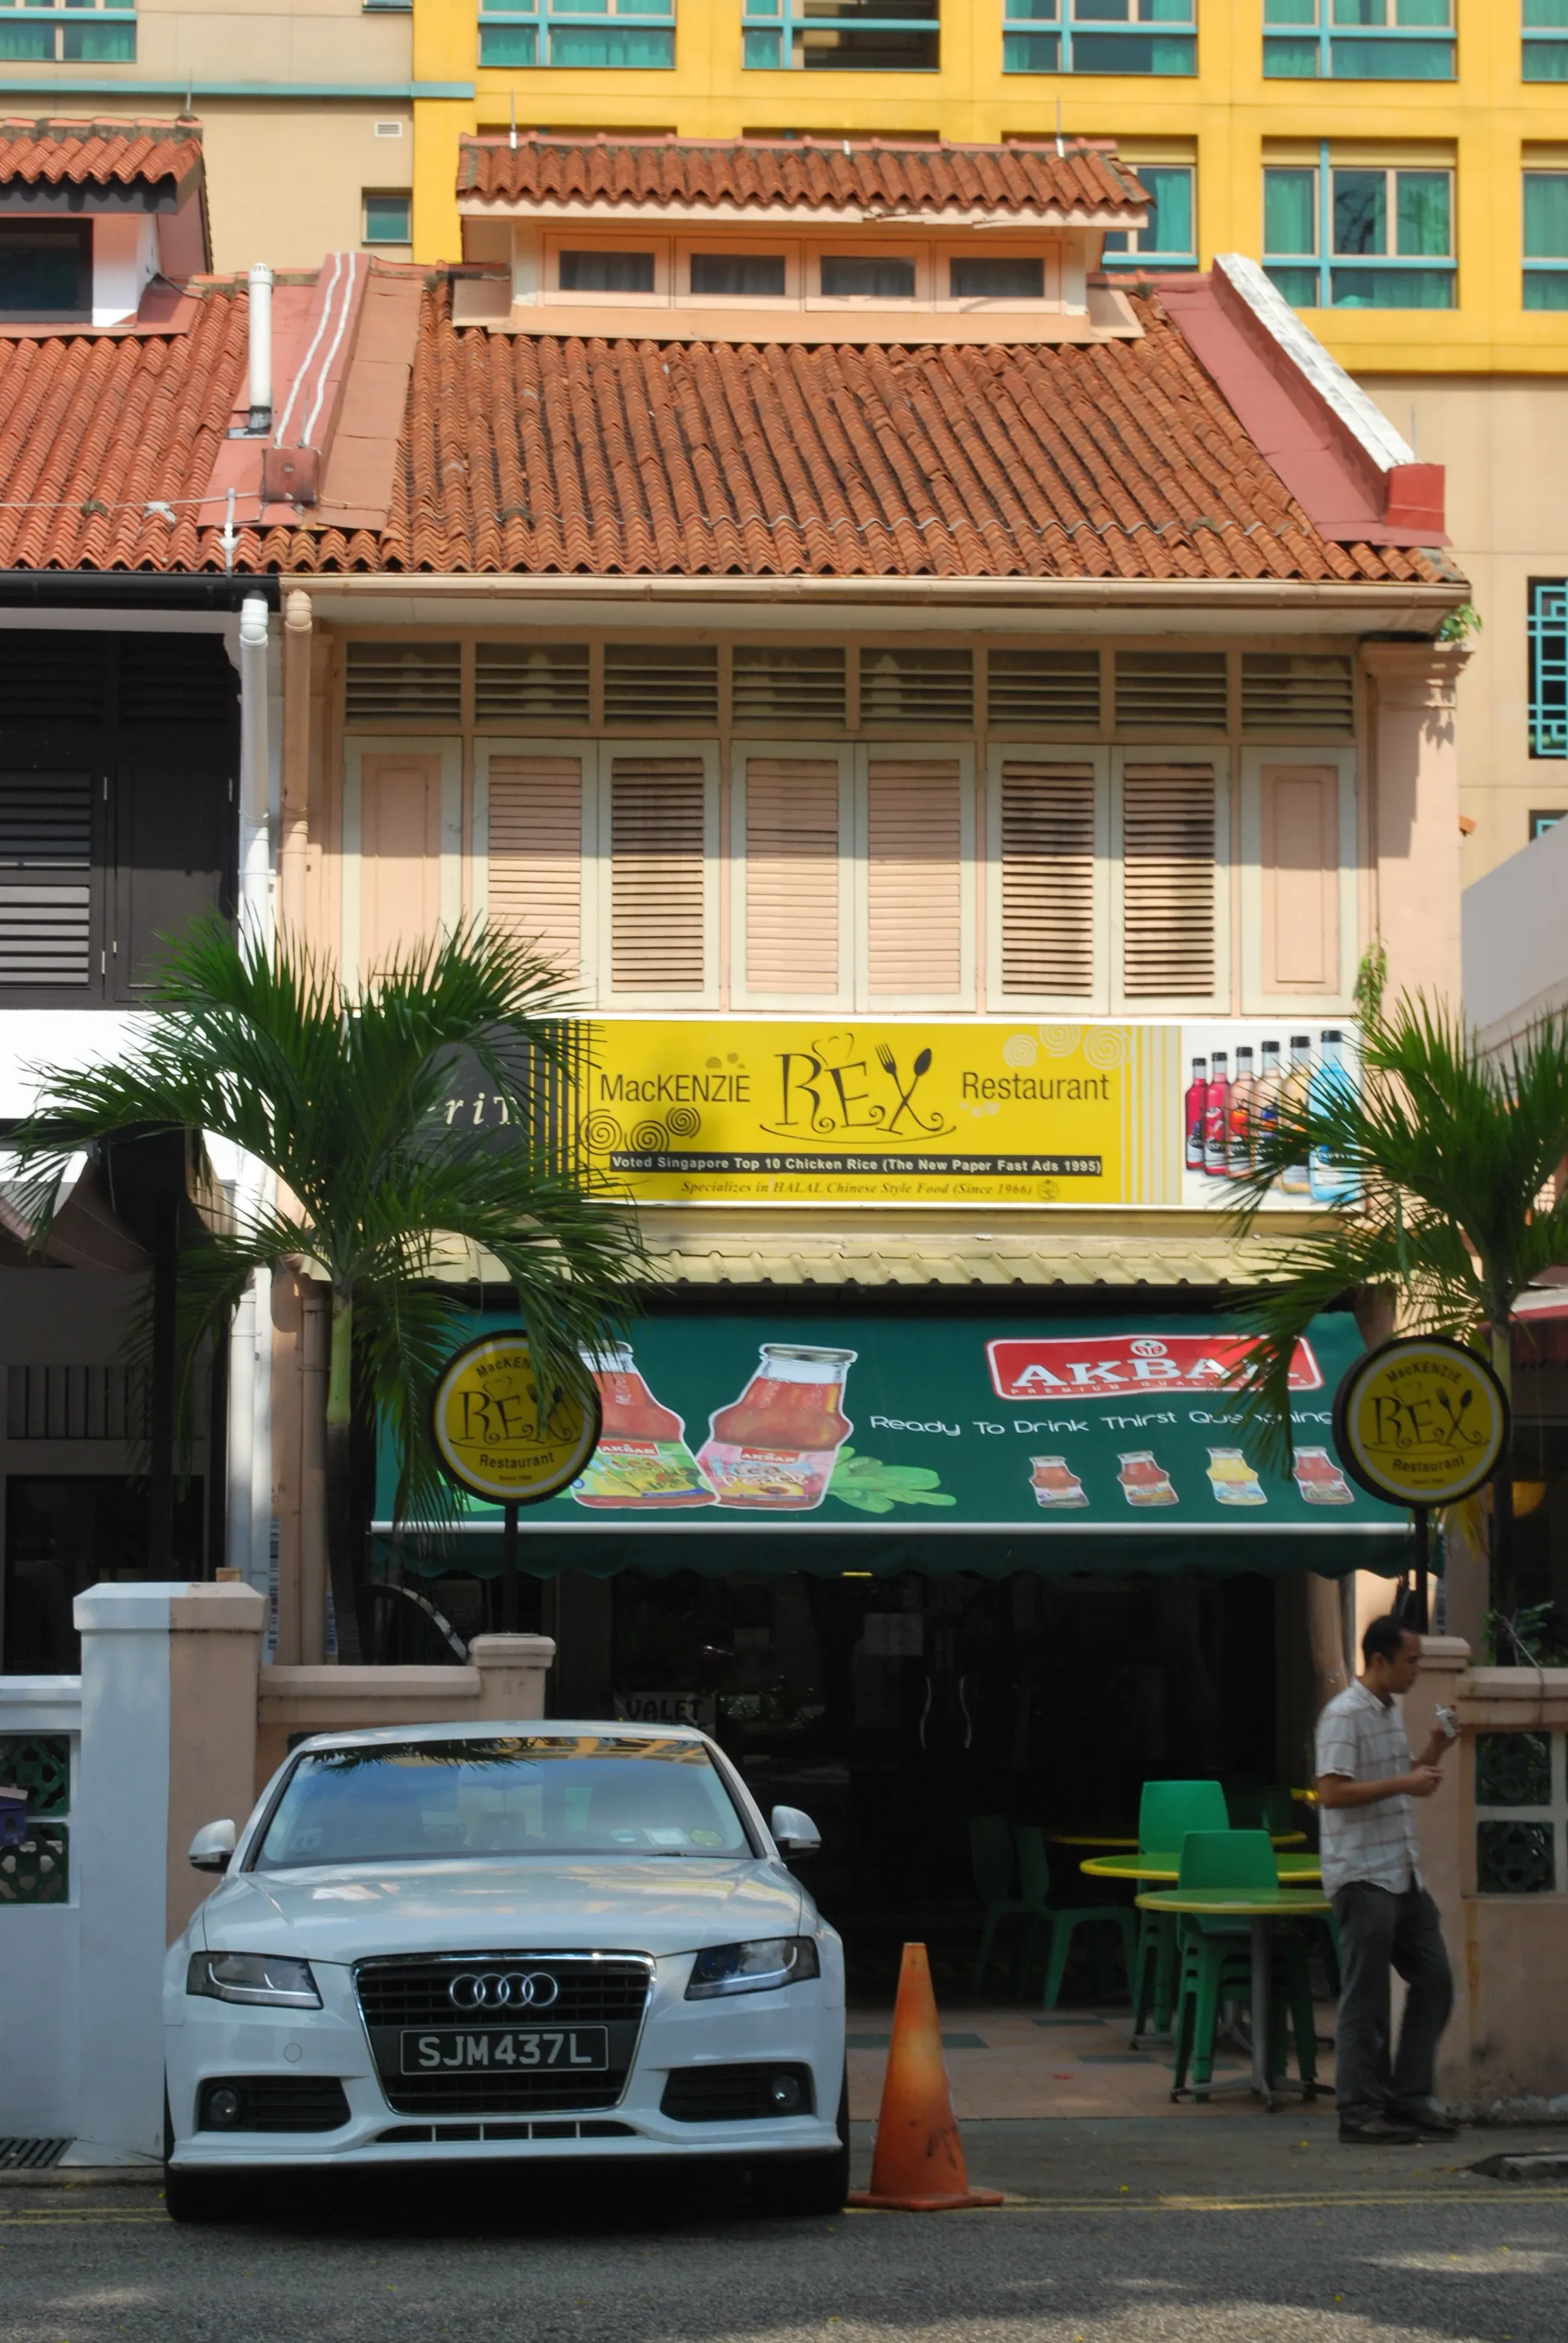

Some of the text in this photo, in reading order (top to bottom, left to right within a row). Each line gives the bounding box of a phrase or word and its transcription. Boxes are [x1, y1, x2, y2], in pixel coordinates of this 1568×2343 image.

[600, 1043, 1110, 1135] MacKENZIE REX Restaurant
[612, 1156, 1102, 1174] Voted Singapore Top 10 Chicken Rice (The New Paper Fast Ads 1995)
[681, 1181, 1032, 1196] Specializes in HALAL Chinese Style Food (Since 1966)
[475, 1356, 535, 1378] MacKEN
[1011, 1357, 1300, 1387] AKBA
[1010, 1383, 1120, 1395] PREMIUM
[869, 1415, 961, 1437] Ready
[972, 1420, 1005, 1435] To
[1013, 1418, 1089, 1434] Drink
[1100, 1411, 1177, 1430] Thirst
[1370, 1387, 1481, 1450] REX
[480, 1452, 555, 1469] Restaurant
[742, 1452, 795, 1463] AKBAR
[1393, 1454, 1466, 1474] Restaurant
[626, 1699, 704, 1720] VALET
[418, 2033, 593, 2067] SJM437L
